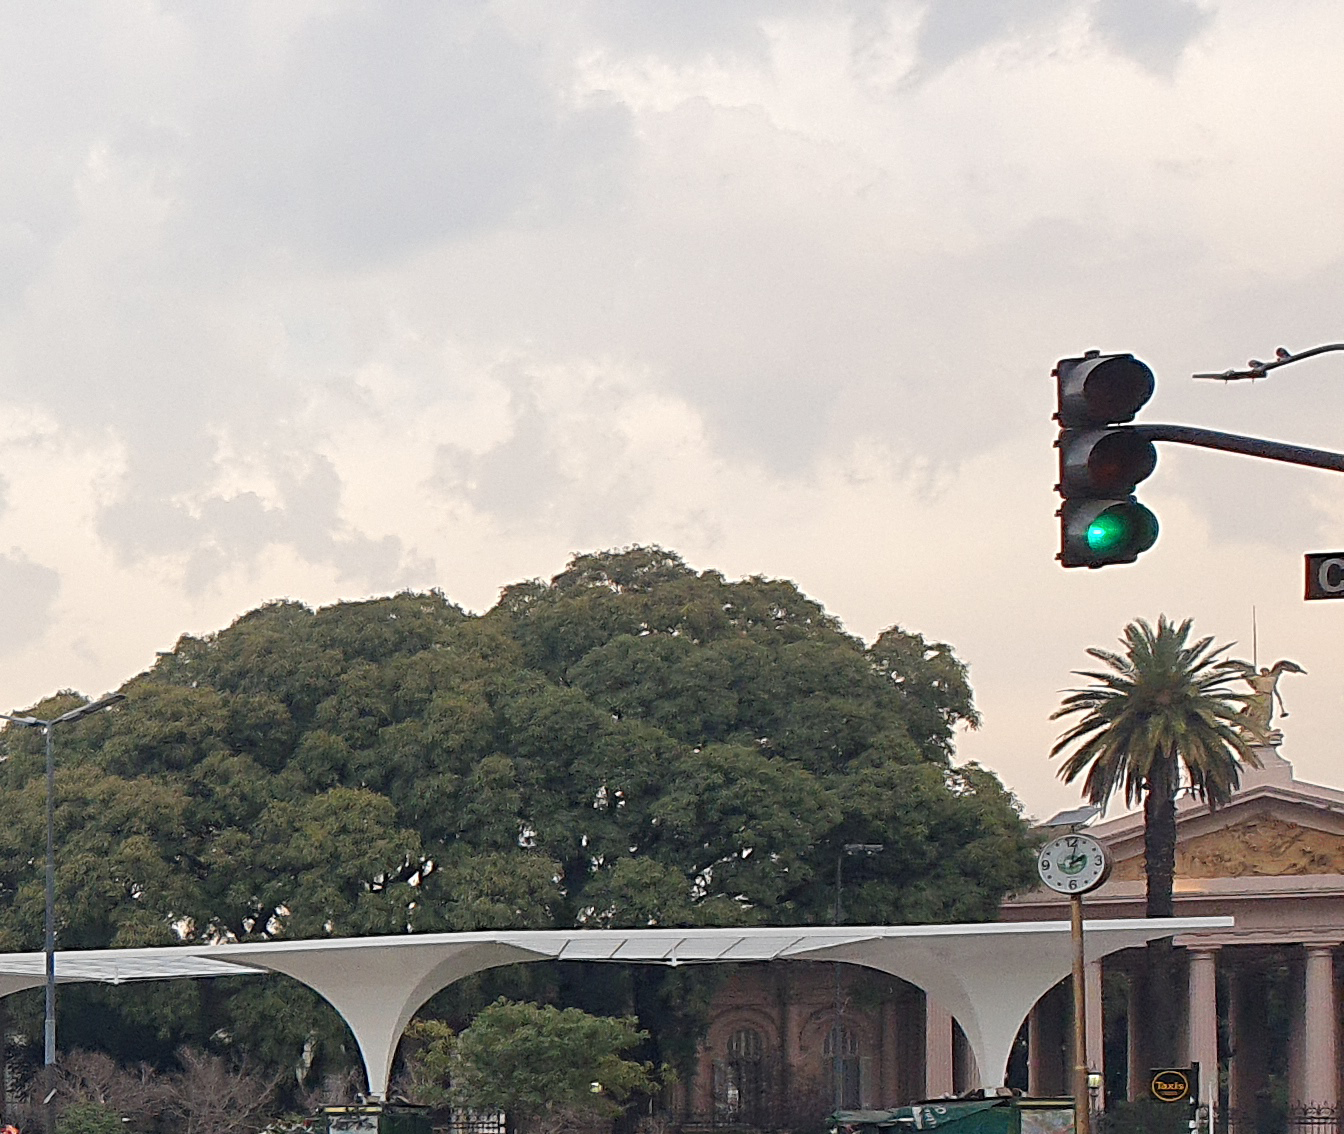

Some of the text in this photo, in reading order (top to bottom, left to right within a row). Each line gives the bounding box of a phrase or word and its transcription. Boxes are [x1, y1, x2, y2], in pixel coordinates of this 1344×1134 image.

[1042, 855, 1102, 870] 9 3
[1069, 880, 1077, 890] 6
[1155, 1082, 1185, 1090] Taxis
